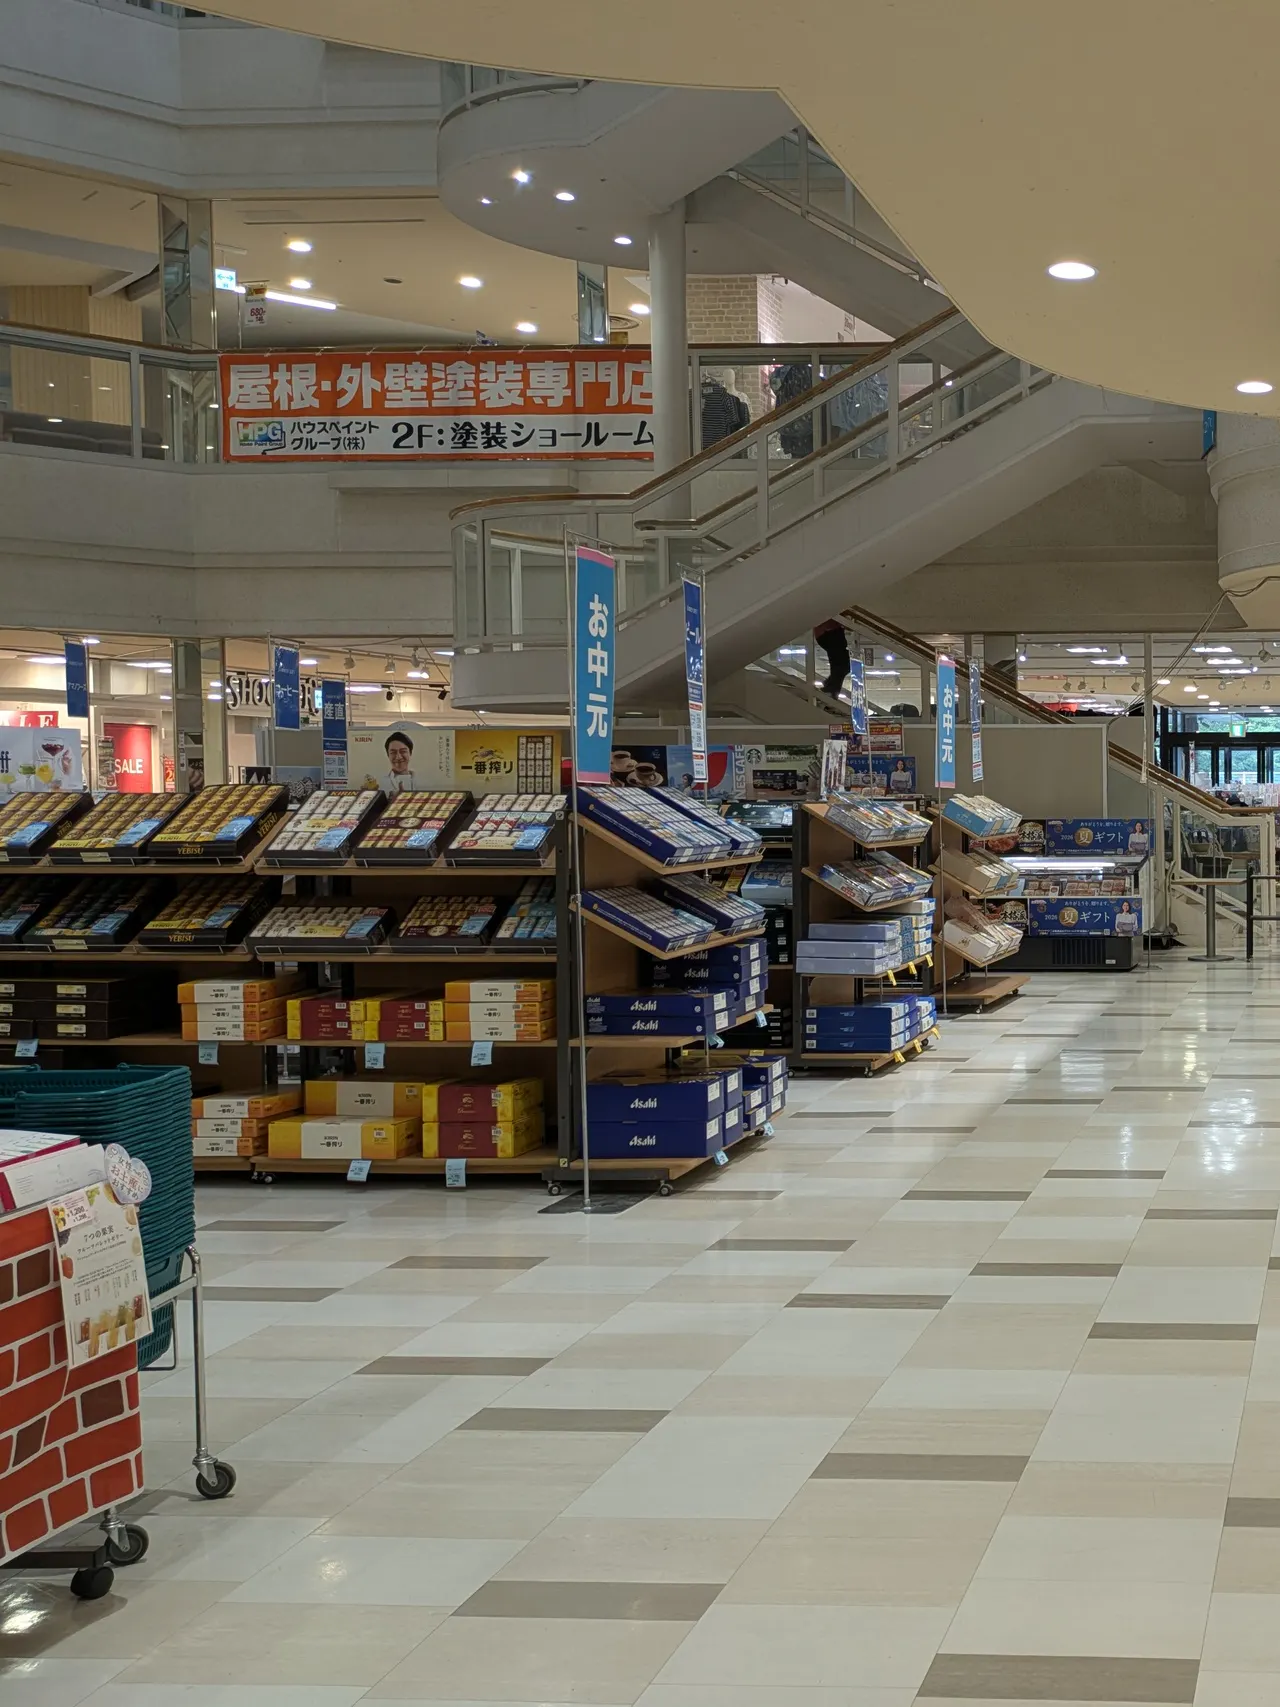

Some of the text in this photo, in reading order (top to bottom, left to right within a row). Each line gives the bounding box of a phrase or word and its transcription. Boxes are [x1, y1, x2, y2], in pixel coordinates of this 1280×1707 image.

[228, 360, 653, 410] 屋根・外壁塗装専門店
[238, 422, 282, 441] HPG
[290, 421, 380, 434] ハウスペイント
[586, 594, 609, 738] お中元
[942, 684, 953, 763] お中元
[114, 758, 144, 774] SALE
[460, 760, 514, 775] 一番搾り
[256, 813, 279, 838] YEBISU
[177, 847, 204, 855] YEBISU
[168, 934, 195, 943] YEBISU
[684, 968, 710, 978] Asahi
[630, 1000, 658, 1011] Asahi
[632, 1020, 659, 1031] Asahi
[630, 1098, 657, 1109] Asahi
[629, 1135, 656, 1146] Asahi
